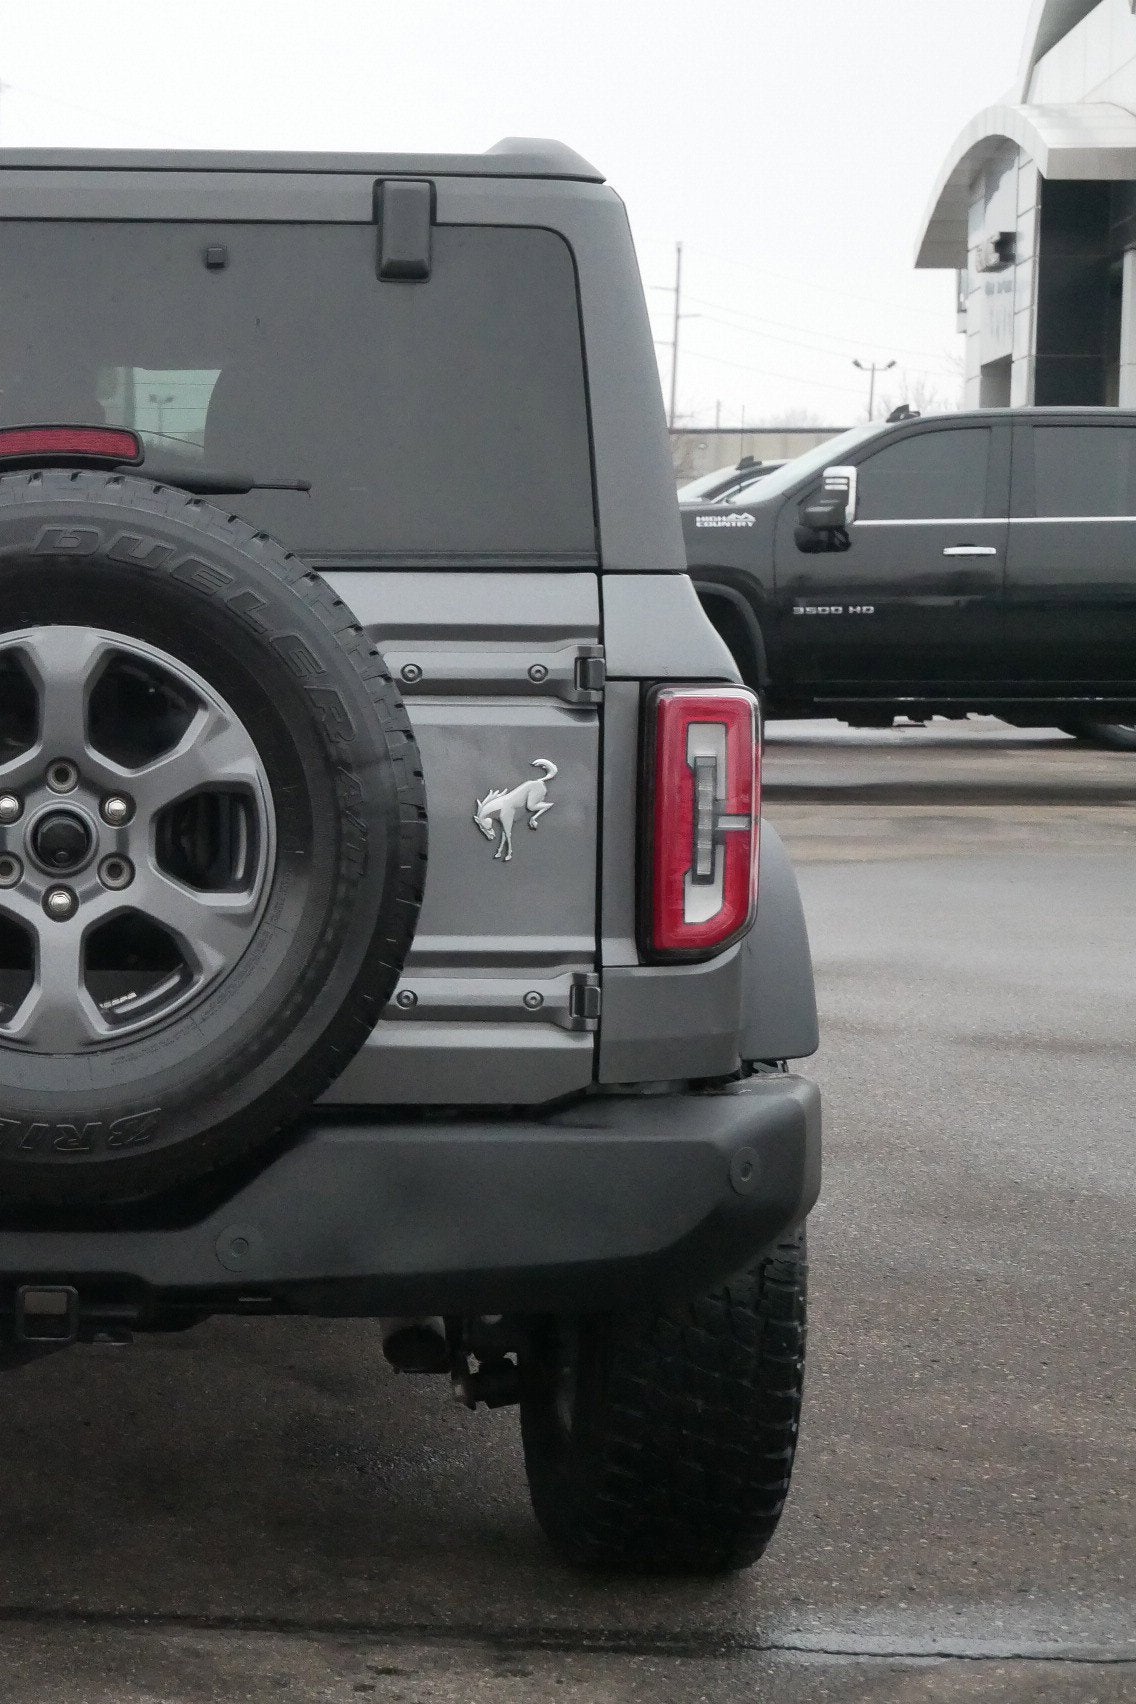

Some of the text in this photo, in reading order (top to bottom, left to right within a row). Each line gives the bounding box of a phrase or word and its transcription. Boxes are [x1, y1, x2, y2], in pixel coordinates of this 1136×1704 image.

[32, 523, 357, 744] DUELER
[793, 605, 875, 615] 3500 HD
